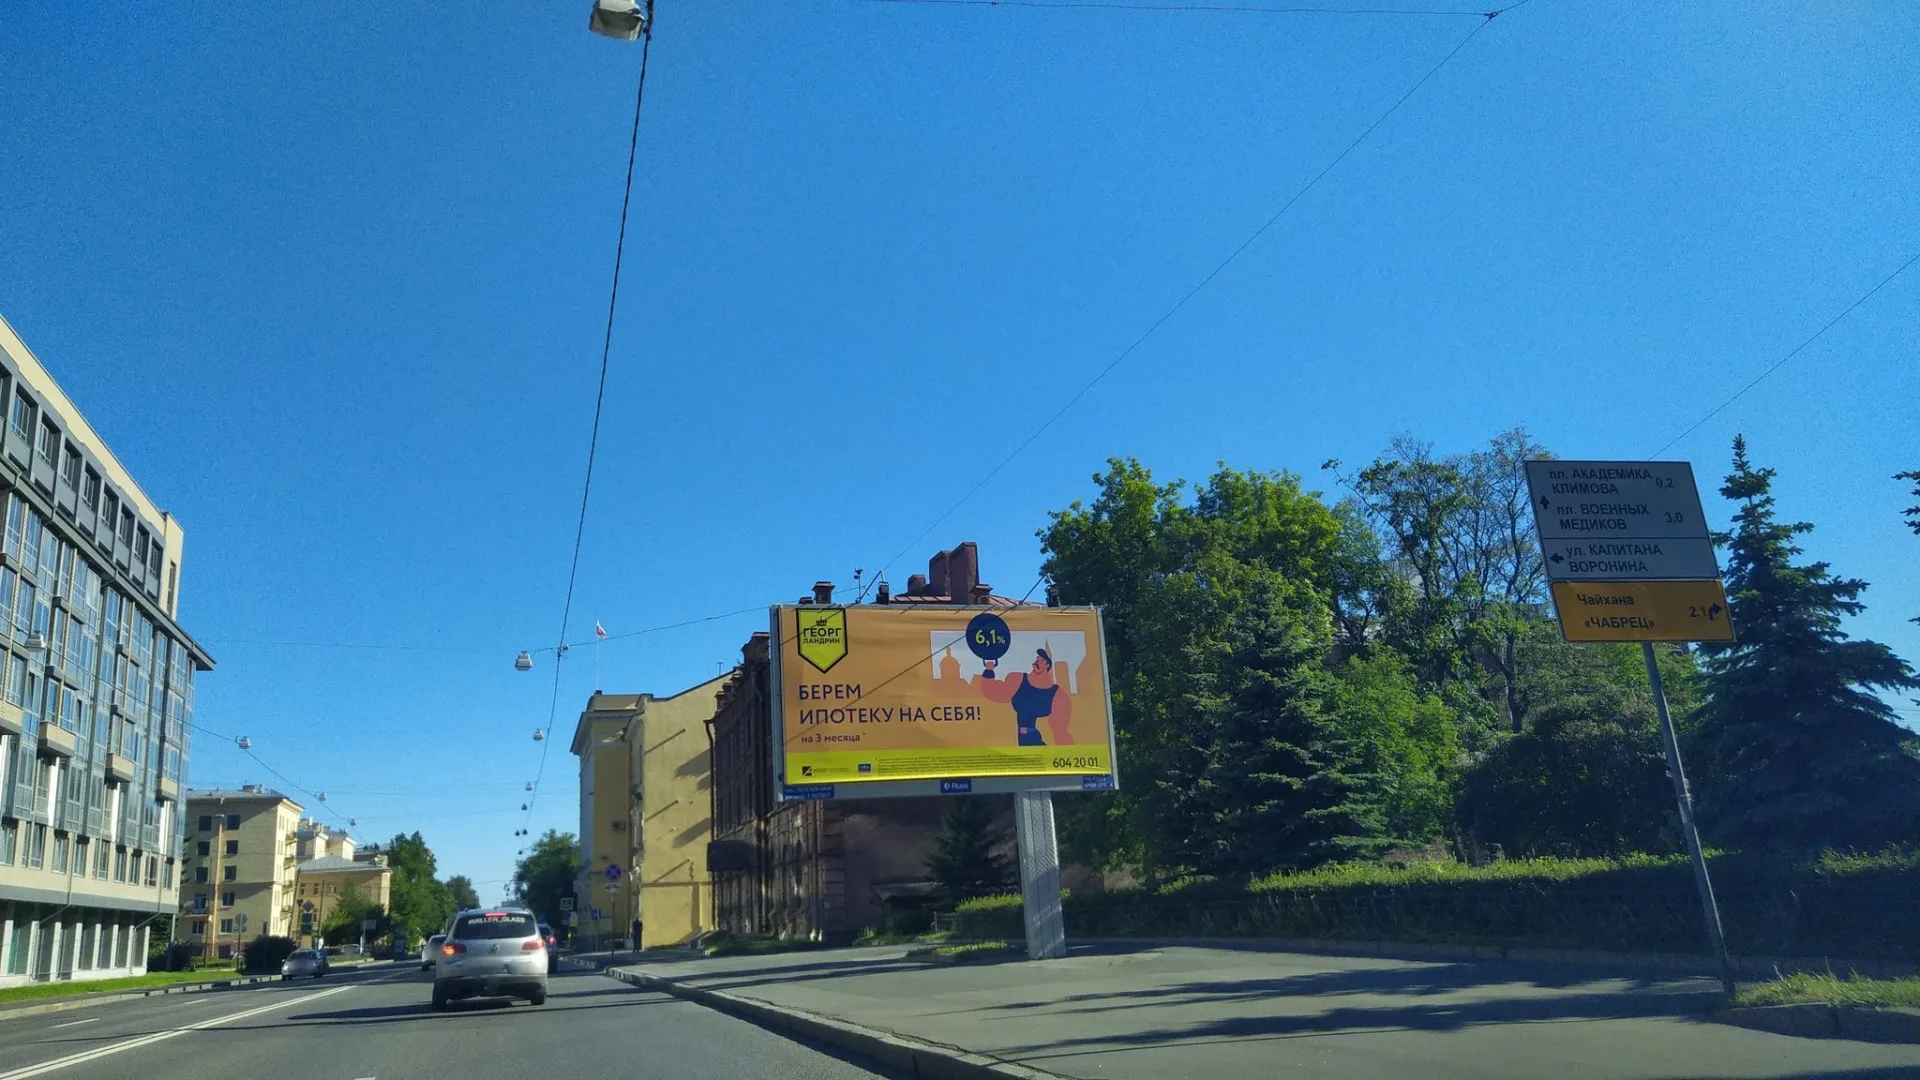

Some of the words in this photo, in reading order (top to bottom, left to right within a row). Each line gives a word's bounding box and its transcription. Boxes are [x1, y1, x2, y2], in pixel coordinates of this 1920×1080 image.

[1550, 471, 1568, 480] пл.
[1572, 469, 1652, 481] АКАДЕМИКА
[1552, 483, 1619, 494] КЛИМОВА
[1655, 477, 1674, 489] 0,2
[1557, 507, 1577, 515] пл.
[1581, 503, 1650, 515] ВОЕННЫХ
[1560, 518, 1627, 532] МЕДИКОВ
[1566, 547, 1586, 557] ул.
[1589, 544, 1663, 556] КАПИТАНА
[1569, 560, 1648, 572] ВОРОНИНА
[1577, 593, 1635, 606] Чайхана
[803, 627, 842, 638] ГЕОРГ
[975, 629, 1006, 647] 6,1%
[802, 637, 840, 645] ЛАНДРИН
[799, 684, 862, 700] БЕРЕМ
[800, 707, 894, 725] ИПОТЕКУ
[900, 708, 926, 722] НА
[930, 706, 981, 721] СЕБЯ!
[801, 735, 813, 743] на
[815, 733, 822, 742] 3
[1053, 757, 1072, 768] 604
[1074, 757, 1086, 767] 20
[1088, 757, 1099, 767] 01
